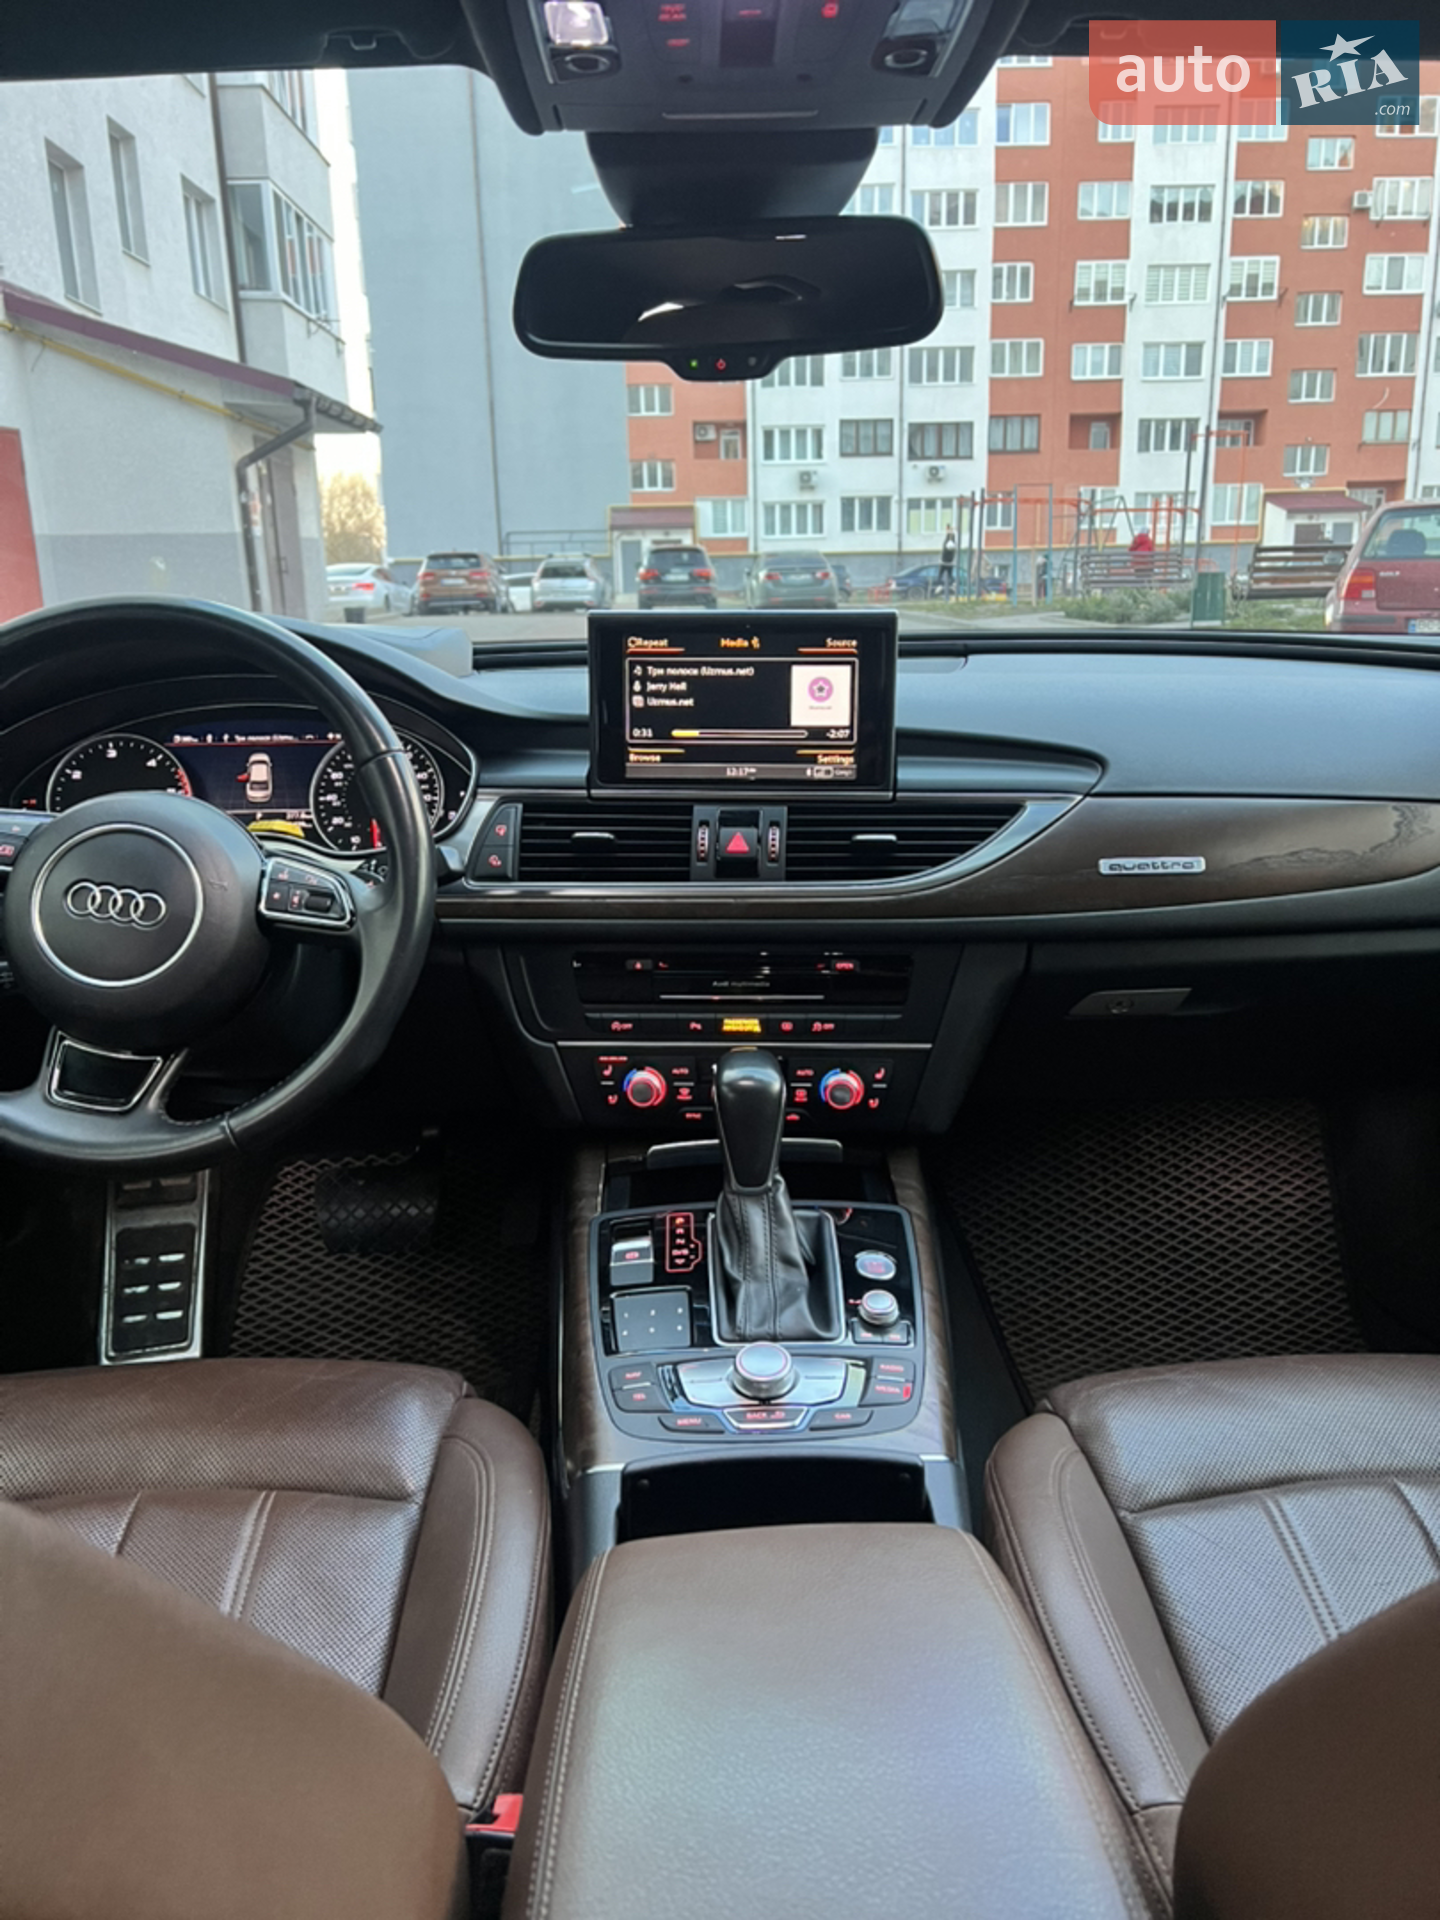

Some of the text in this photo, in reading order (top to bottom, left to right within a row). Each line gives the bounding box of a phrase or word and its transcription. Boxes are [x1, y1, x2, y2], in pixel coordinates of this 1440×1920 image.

[721, 638, 749, 648] Media
[826, 638, 858, 648] Source
[145, 758, 158, 768] 4
[817, 754, 855, 767] Settings
[1109, 861, 1196, 873] quattro
[746, 1411, 768, 1420] BACK
[676, 1417, 702, 1427] MENU
